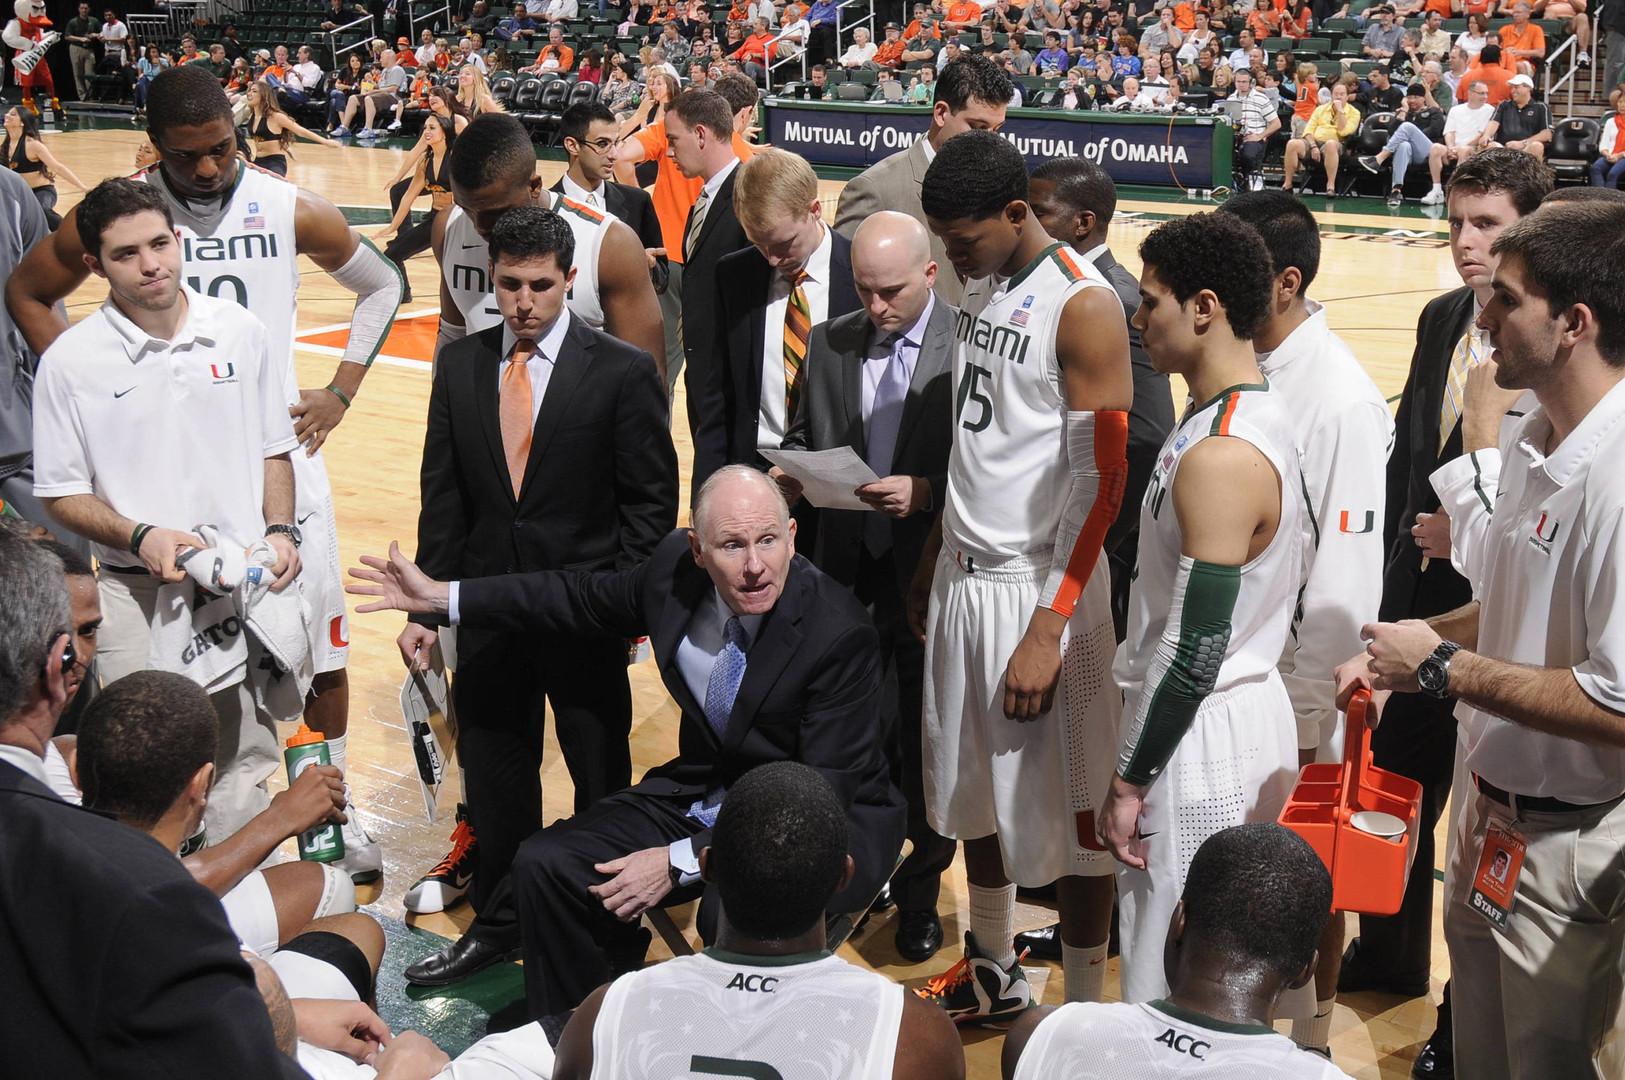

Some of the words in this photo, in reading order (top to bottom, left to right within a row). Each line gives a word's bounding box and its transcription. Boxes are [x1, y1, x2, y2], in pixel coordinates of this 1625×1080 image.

[21, 39, 53, 71] MIAMI
[785, 121, 855, 146] MUTUAL
[859, 125, 881, 152] of
[999, 132, 1079, 158] MUTUAL
[1083, 136, 1110, 165] of
[1111, 138, 1189, 164] OMAHA
[183, 233, 278, 262] IAMI
[957, 309, 1031, 365] MIAMI
[211, 362, 235, 379] U
[957, 361, 993, 433] 15
[1340, 510, 1375, 534] U
[1536, 513, 1559, 543] U
[1473, 892, 1502, 921] STAFF
[725, 972, 780, 993] ACC
[1154, 1028, 1212, 1061] ACC
